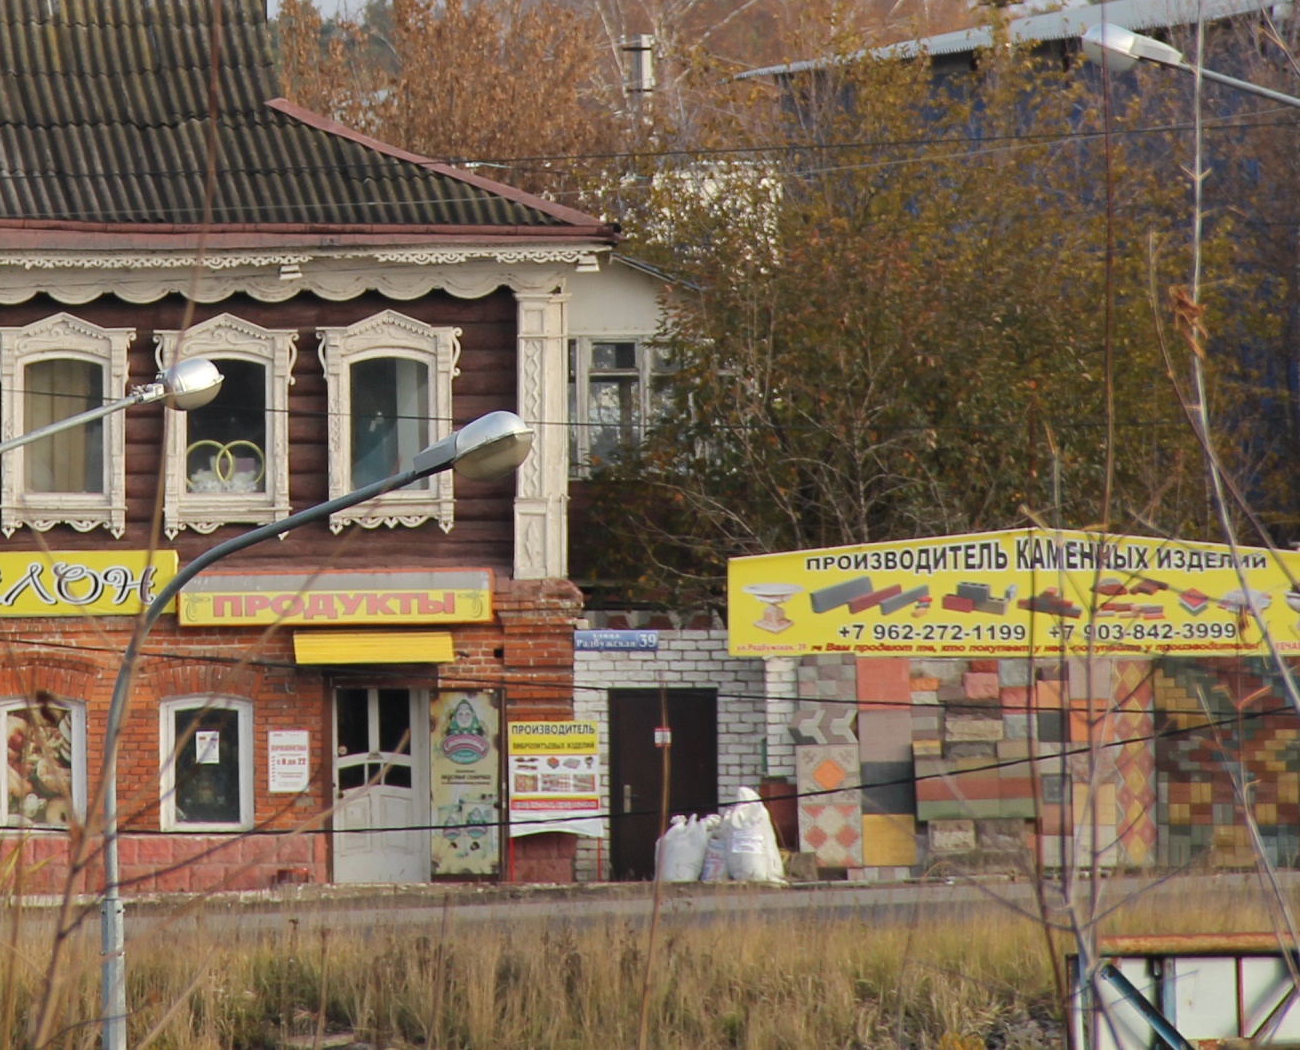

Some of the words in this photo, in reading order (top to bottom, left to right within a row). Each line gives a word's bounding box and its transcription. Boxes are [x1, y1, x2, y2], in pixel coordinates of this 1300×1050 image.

[806, 542, 1007, 574] ПРОИЗВОДИТЕЛЬ
[1016, 538, 1149, 570] КАМЕННЫХ
[1156, 547, 1267, 571] ИЗДЕЛИЙ
[212, 592, 455, 619] ПРОДУКТЫ
[639, 633, 657, 648] 39
[839, 625, 864, 639] +7
[874, 625, 1026, 640] 962-272-1199
[1049, 625, 1075, 640] +7
[1084, 623, 1237, 641] 903-842-3999
[511, 724, 595, 736] ПРОИЗВОДИТЕЛЬ
